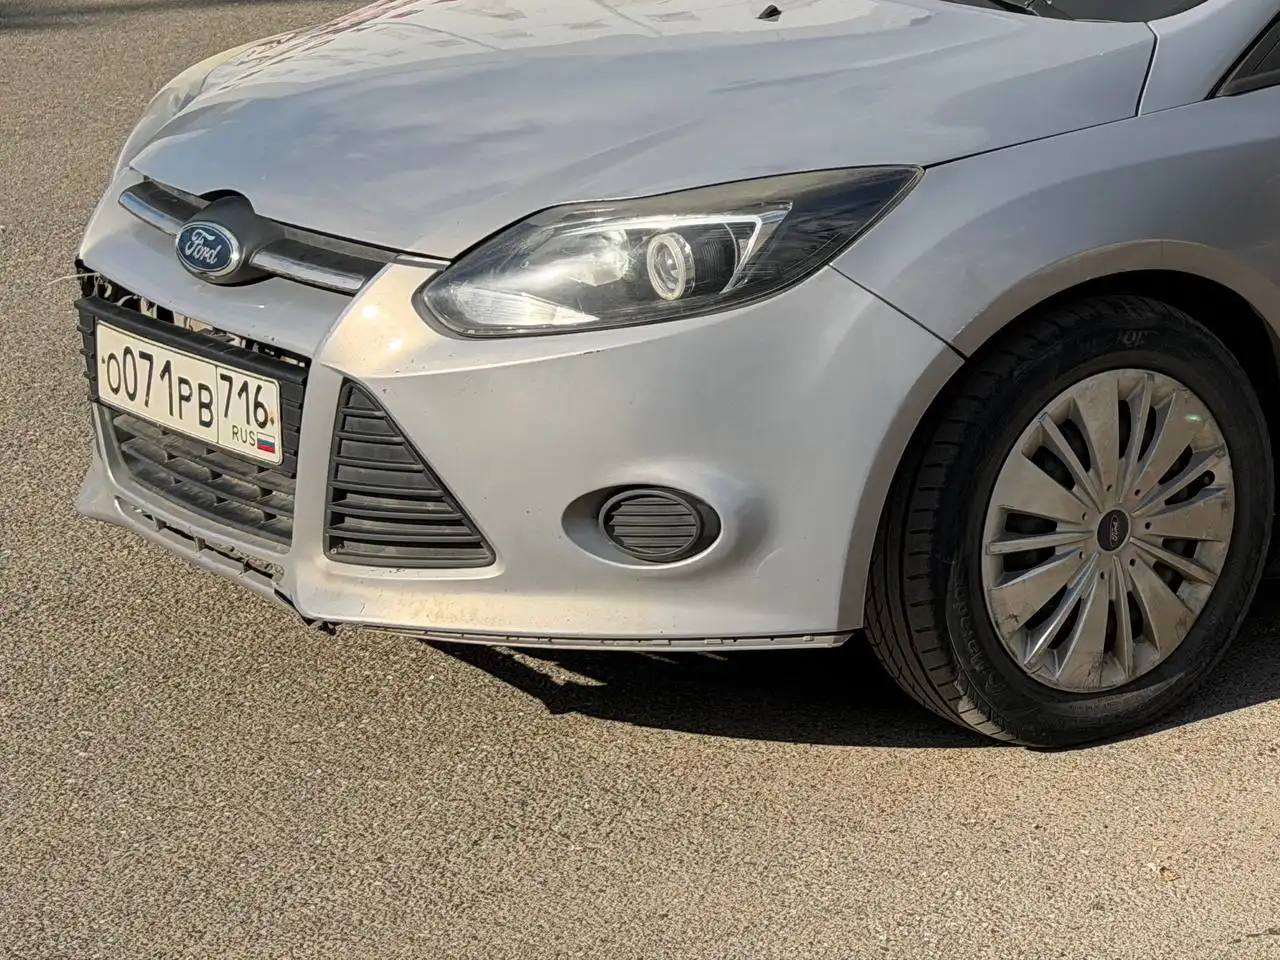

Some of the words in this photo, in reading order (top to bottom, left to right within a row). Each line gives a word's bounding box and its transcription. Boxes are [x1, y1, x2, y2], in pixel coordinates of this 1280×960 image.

[185, 229, 222, 264] Ford
[219, 373, 269, 429] 716
[232, 425, 256, 447] RUS
